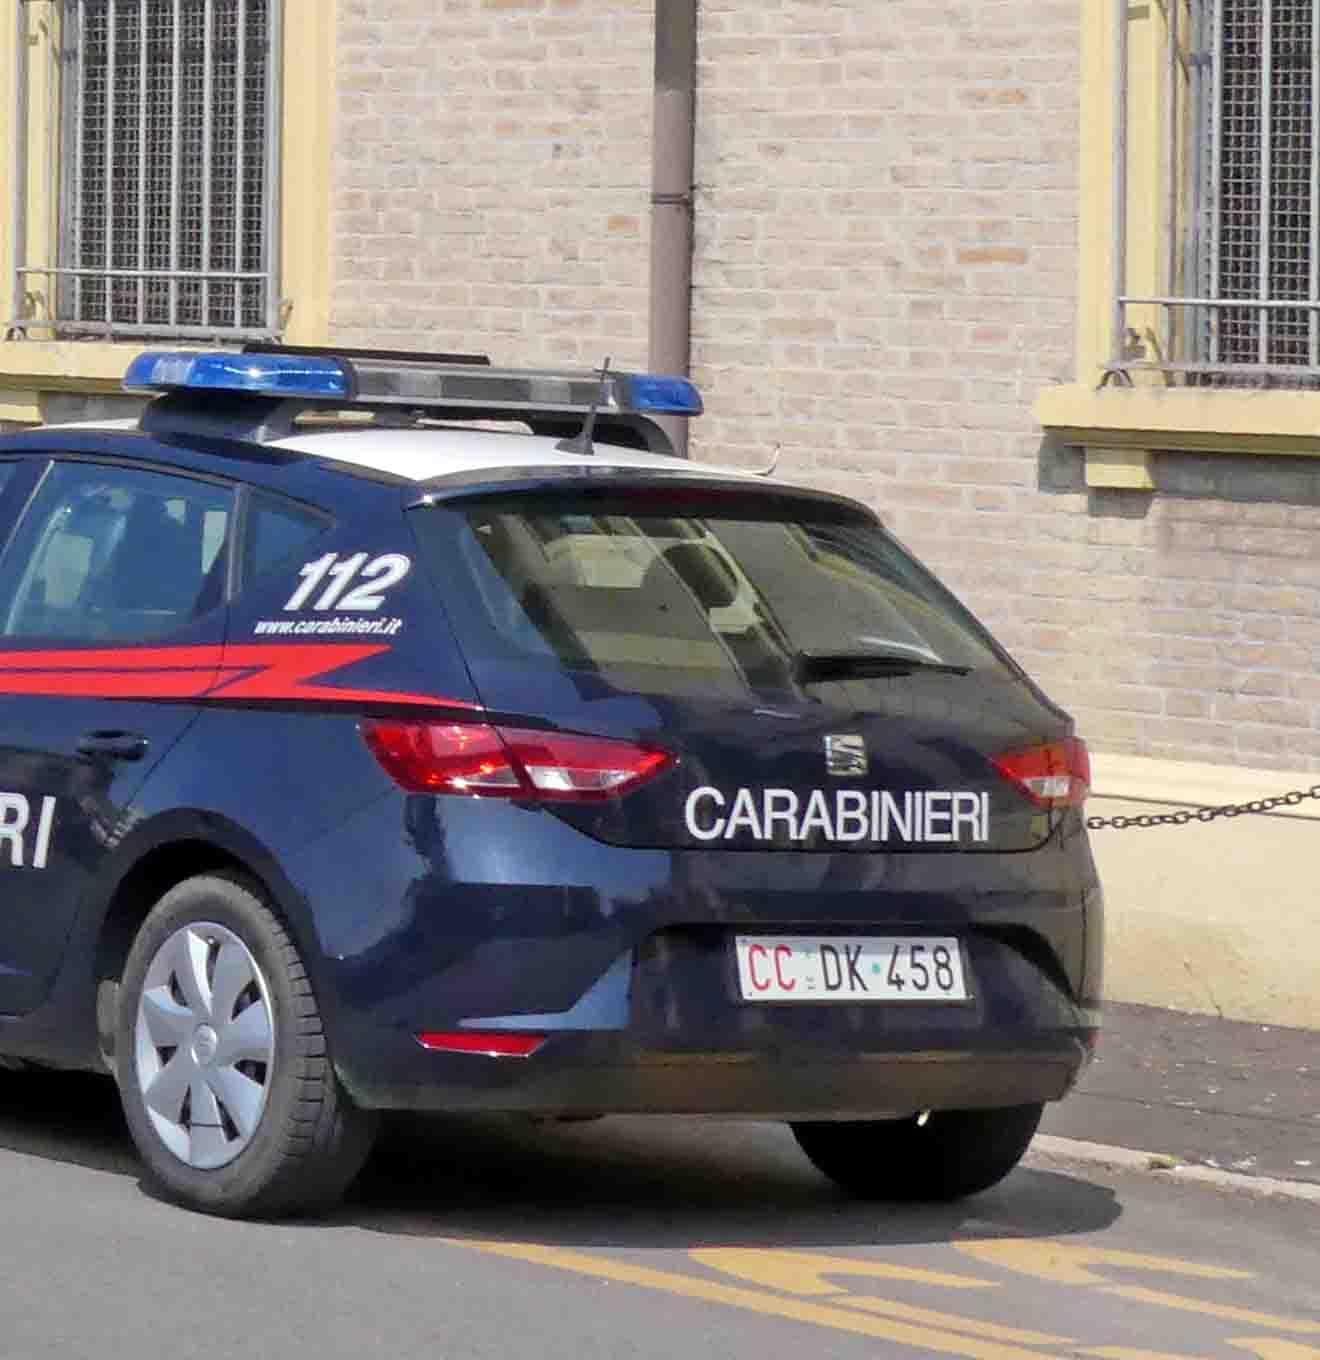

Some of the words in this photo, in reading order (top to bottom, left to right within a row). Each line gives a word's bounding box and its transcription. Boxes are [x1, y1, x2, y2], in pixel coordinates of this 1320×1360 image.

[283, 552, 411, 611] 112
[254, 617, 402, 635] www.carabinieri.it
[685, 787, 989, 841] CARABINIERI
[749, 944, 796, 991] CC
[820, 944, 868, 991] DK
[887, 944, 954, 991] 458
